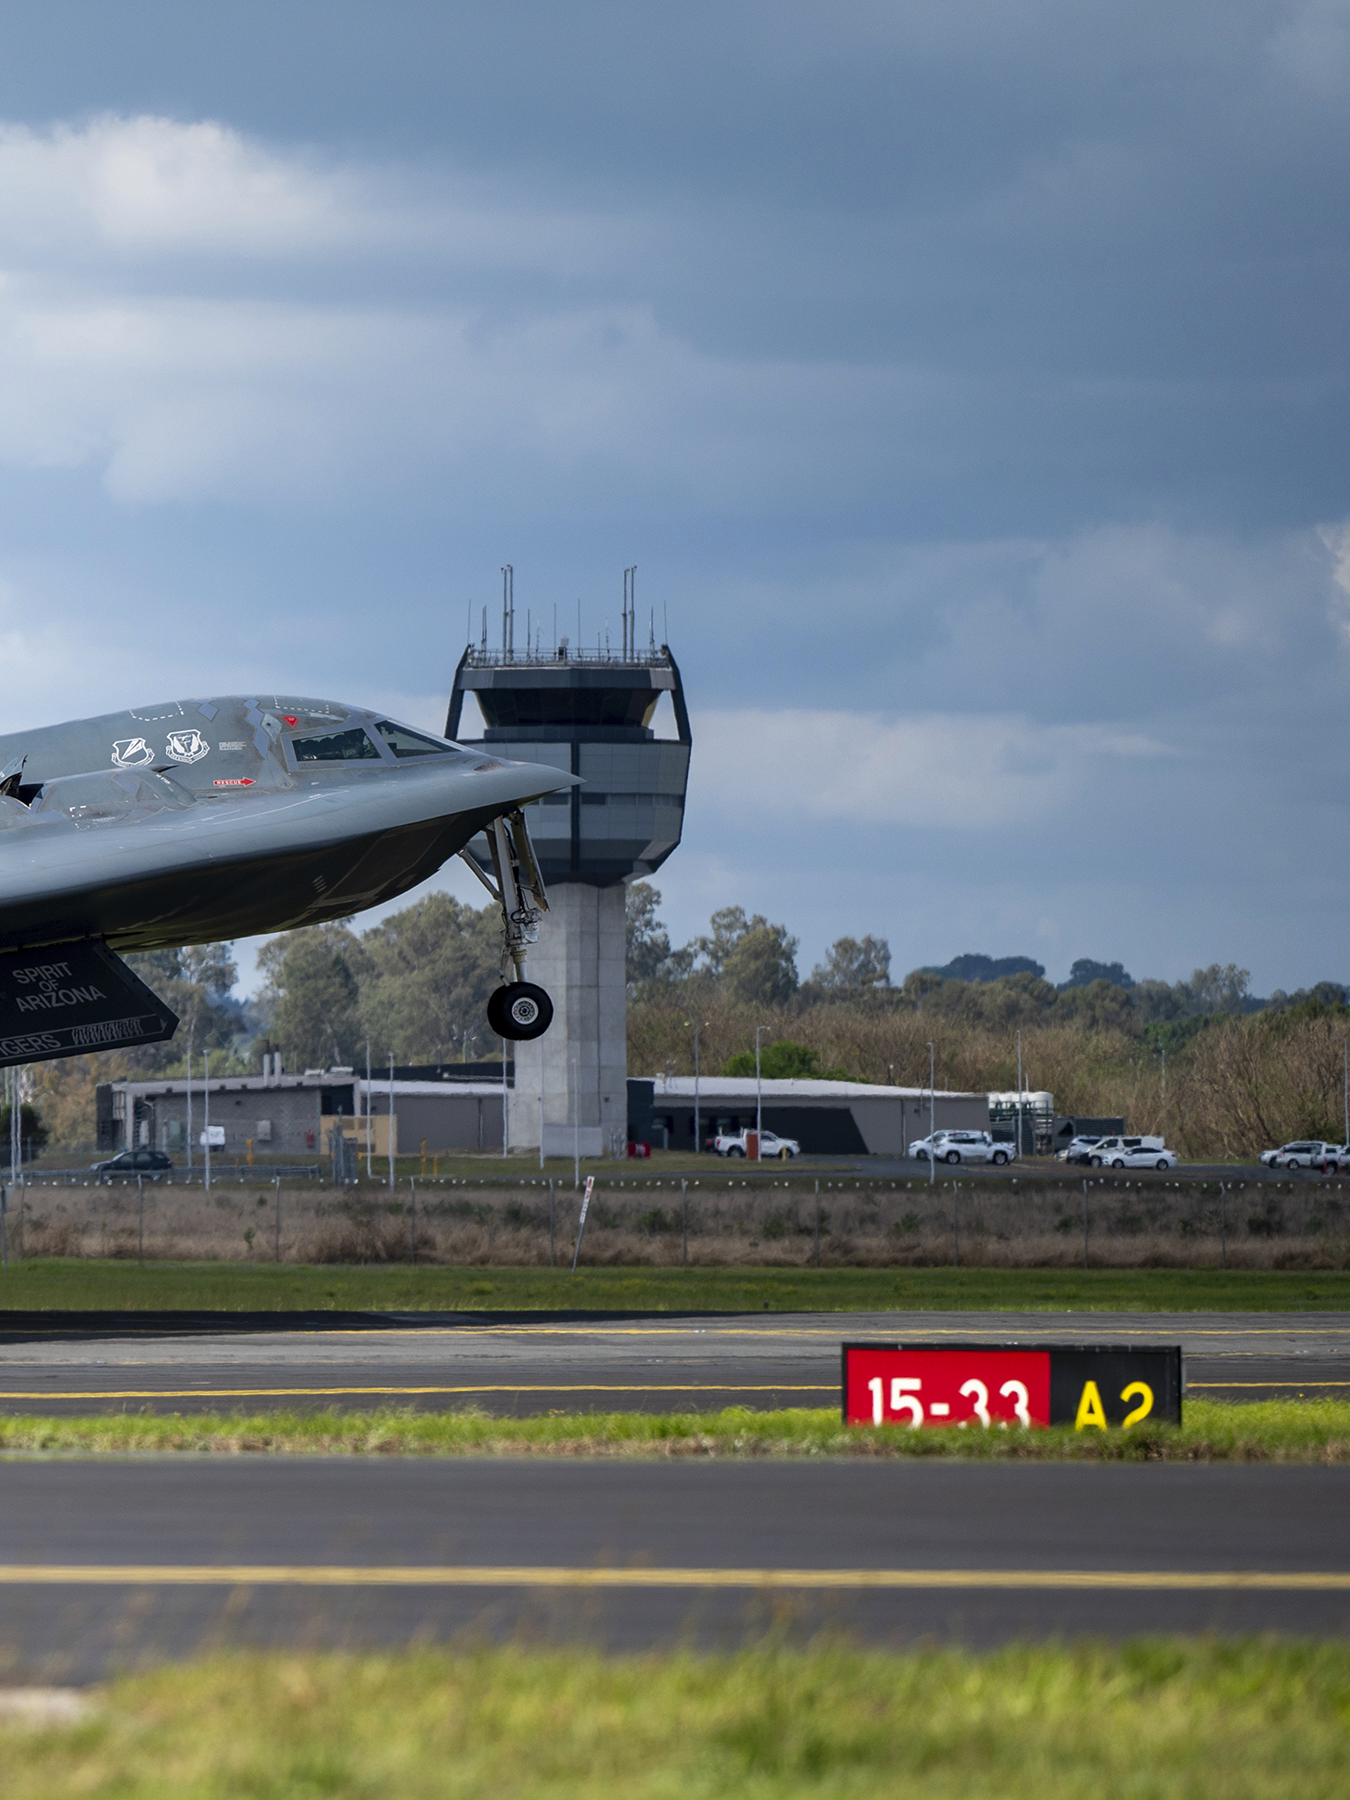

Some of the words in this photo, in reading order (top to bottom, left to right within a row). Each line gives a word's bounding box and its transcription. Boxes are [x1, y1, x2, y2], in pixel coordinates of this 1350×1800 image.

[12, 962, 72, 984] SPIRIT
[39, 978, 60, 992] OF
[15, 985, 107, 1012] ARIZONA
[867, 1377, 1031, 1430] 15-33
